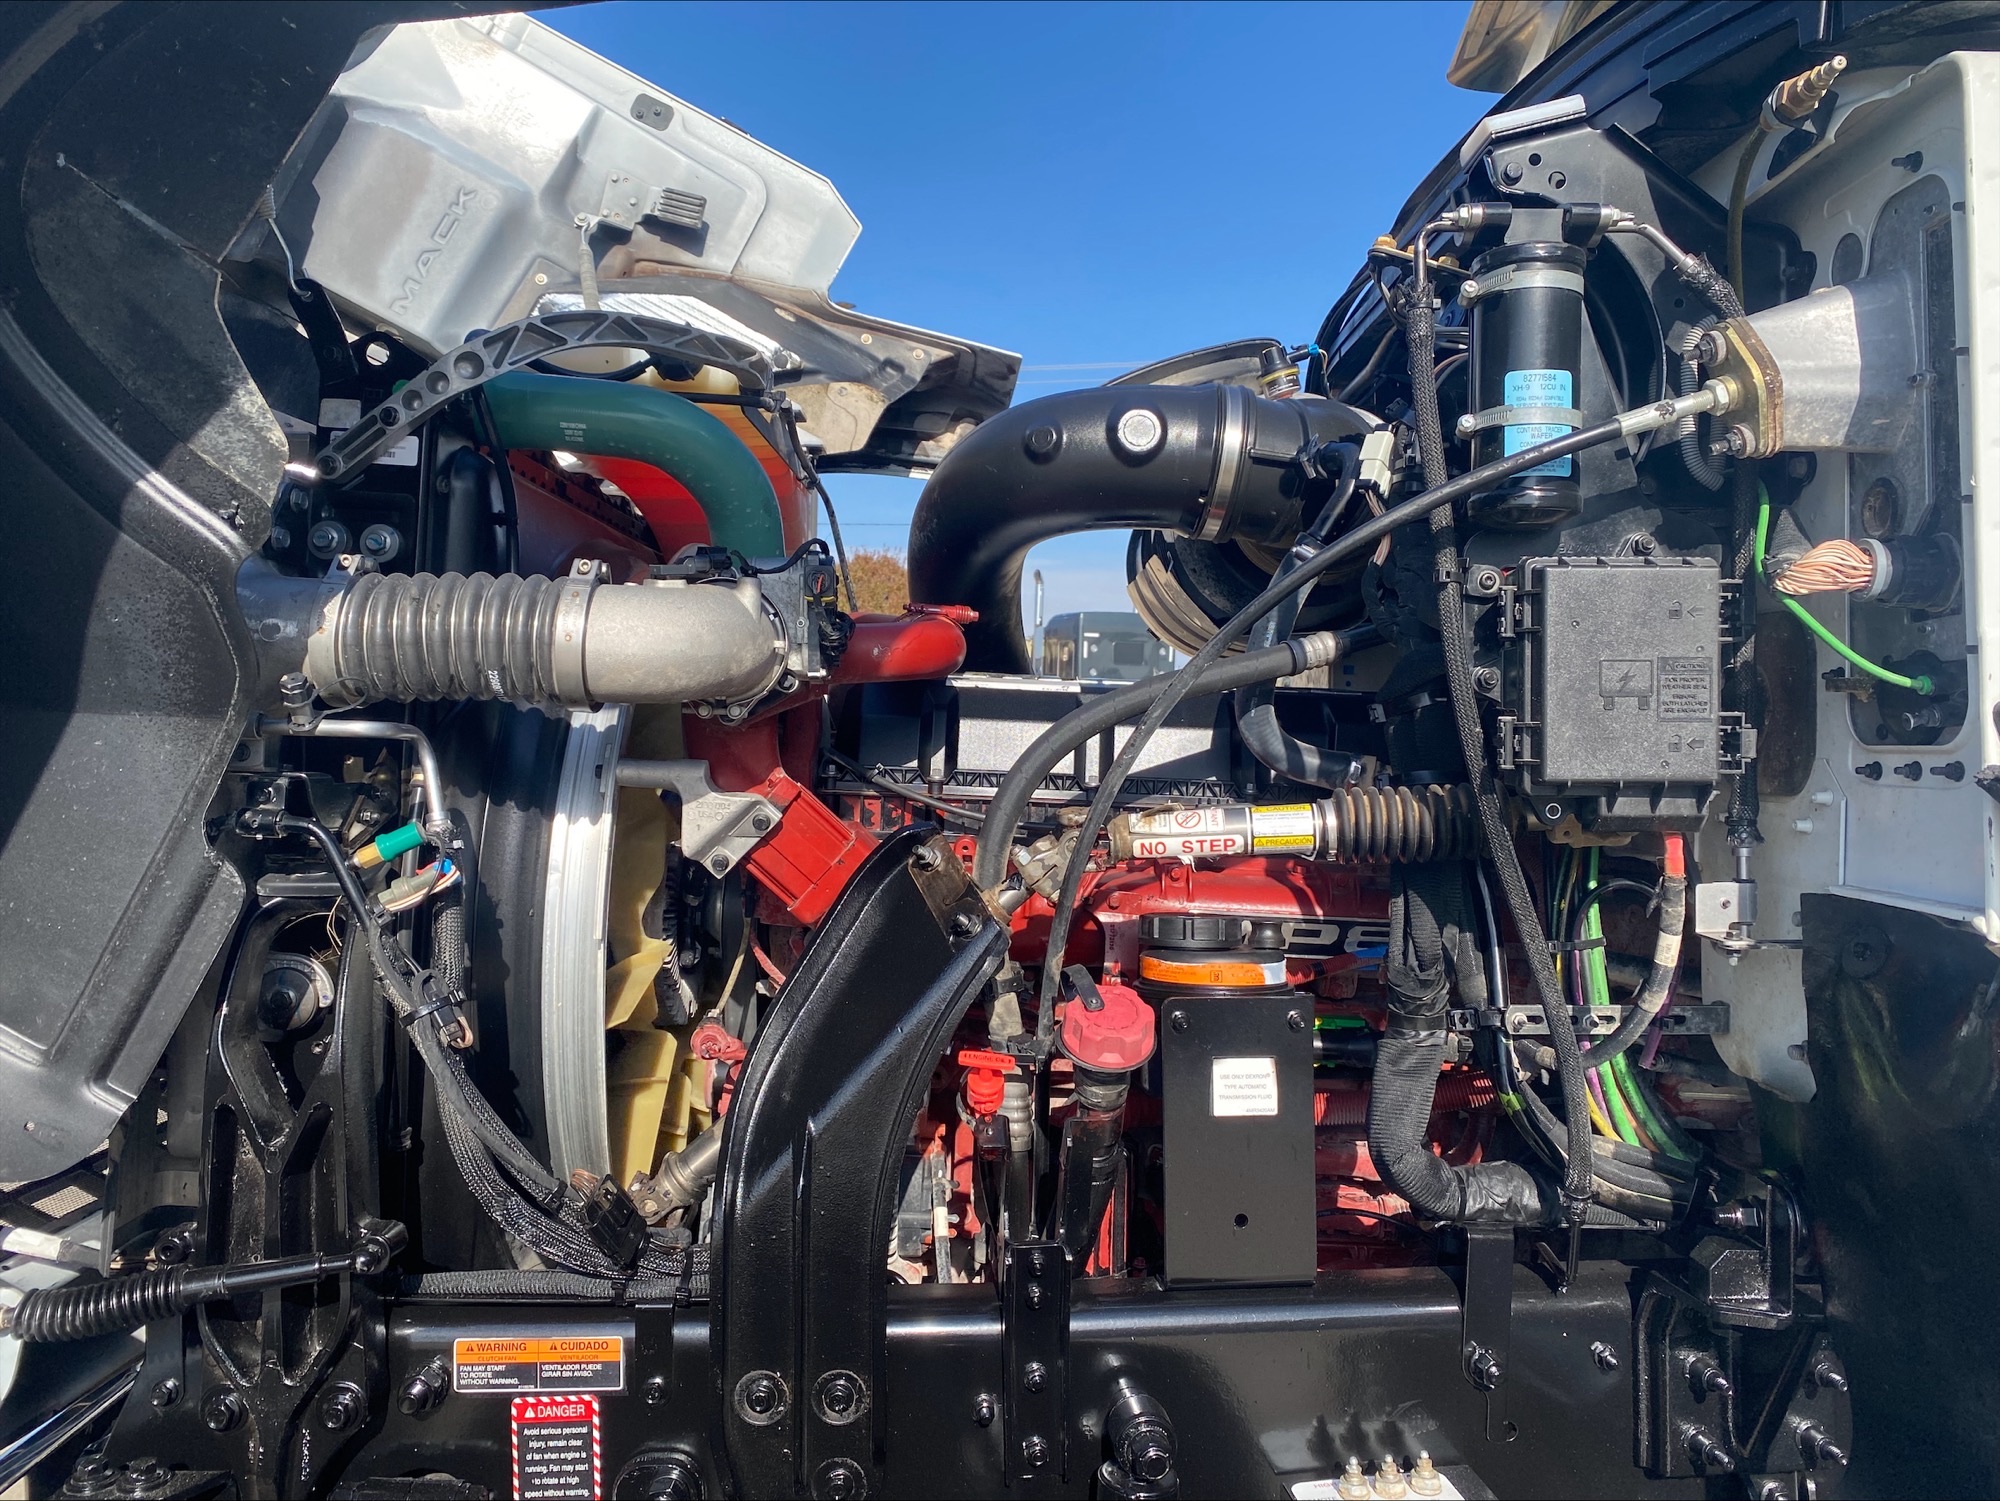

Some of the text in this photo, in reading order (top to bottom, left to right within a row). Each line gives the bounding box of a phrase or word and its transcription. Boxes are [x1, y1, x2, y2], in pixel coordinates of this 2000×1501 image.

[389, 186, 477, 316] MACK
[1516, 426, 1541, 434] CONTAINS
[1265, 836, 1312, 846] PRECAUCIÓN
[1140, 838, 1236, 856] NO STEP
[476, 1342, 527, 1352] WARNING
[560, 1340, 609, 1351] CUIDADO
[537, 1404, 585, 1418] DANGER
[523, 1426, 588, 1436] Avoid serious personal
[528, 1440, 546, 1449] injury,
[547, 1439, 567, 1447] remain
[526, 1452, 533, 1460] of
[533, 1452, 543, 1460] fan
[543, 1452, 559, 1460] when
[560, 1451, 580, 1460] engine
[524, 1463, 589, 1474] running. Fan may start
[534, 1475, 580, 1485] to rotate at high
[524, 1488, 590, 1499] speed without warning.
